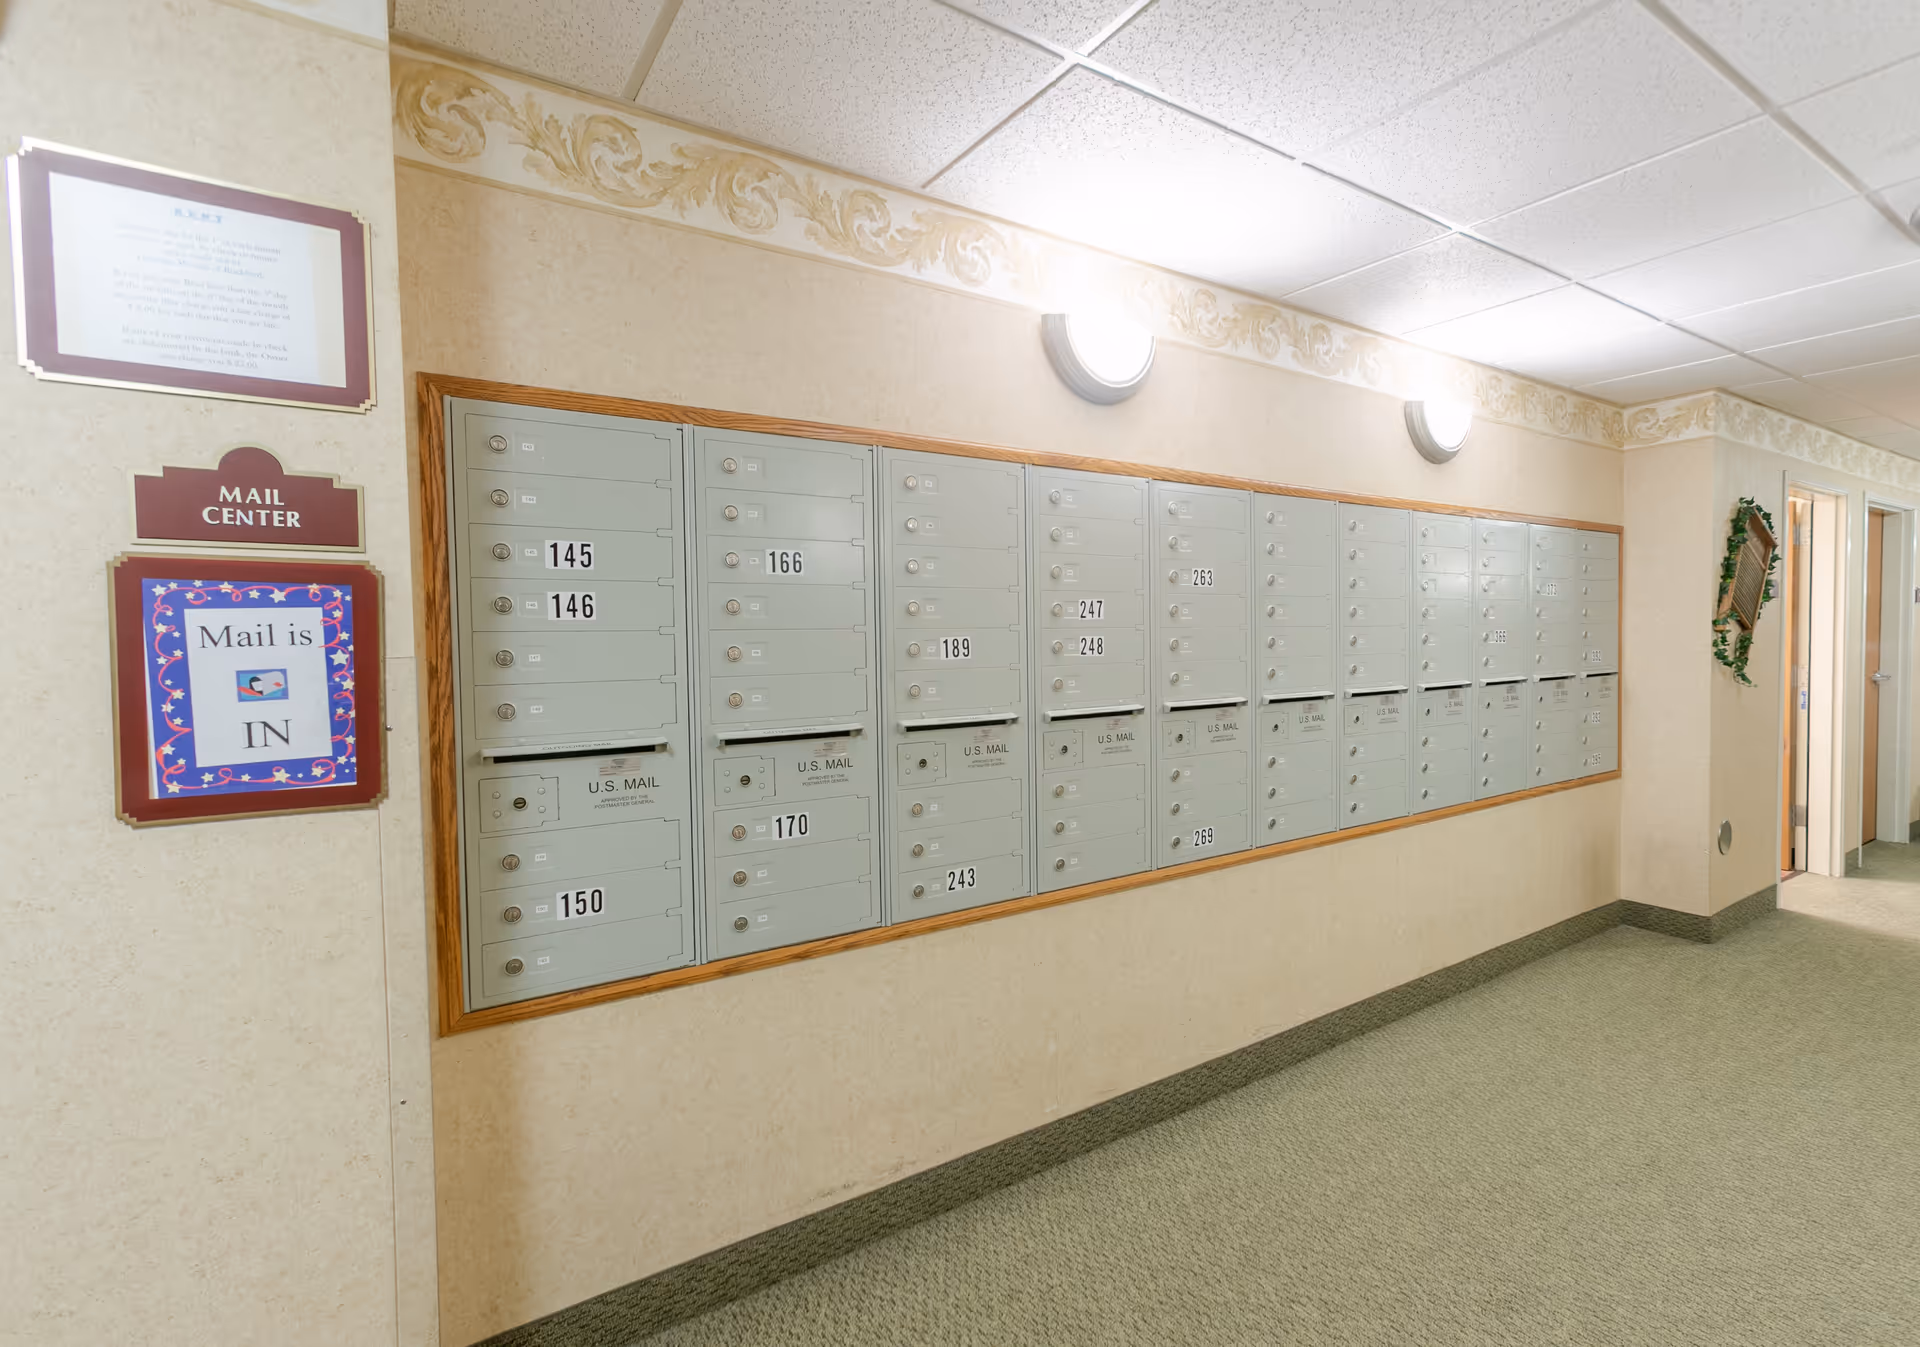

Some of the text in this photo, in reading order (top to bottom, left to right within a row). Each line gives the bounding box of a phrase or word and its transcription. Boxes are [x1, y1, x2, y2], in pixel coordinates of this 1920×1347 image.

[219, 485, 285, 506] MAIL
[201, 506, 301, 528] CENTER
[550, 542, 592, 568] 145
[769, 550, 803, 574] 166
[1193, 569, 1213, 586] 263
[551, 593, 594, 618] 146
[1080, 600, 1103, 619] 247
[199, 623, 313, 648] Mail is
[942, 638, 971, 659] 189
[1080, 637, 1104, 656] 248
[1222, 722, 1239, 732] MAIL
[1311, 714, 1325, 722] MAIL
[240, 718, 292, 749] IN
[1097, 731, 1135, 744] U.S. MAIL
[964, 743, 1009, 757] U.S. MAIL
[797, 757, 854, 773] U.S. MAIL
[588, 776, 661, 794] U.S. MAIL
[594, 801, 631, 809] POSTMASTER
[775, 814, 809, 839] 170
[1194, 828, 1214, 847] 269
[948, 867, 976, 892] 243
[560, 888, 604, 918] 150
